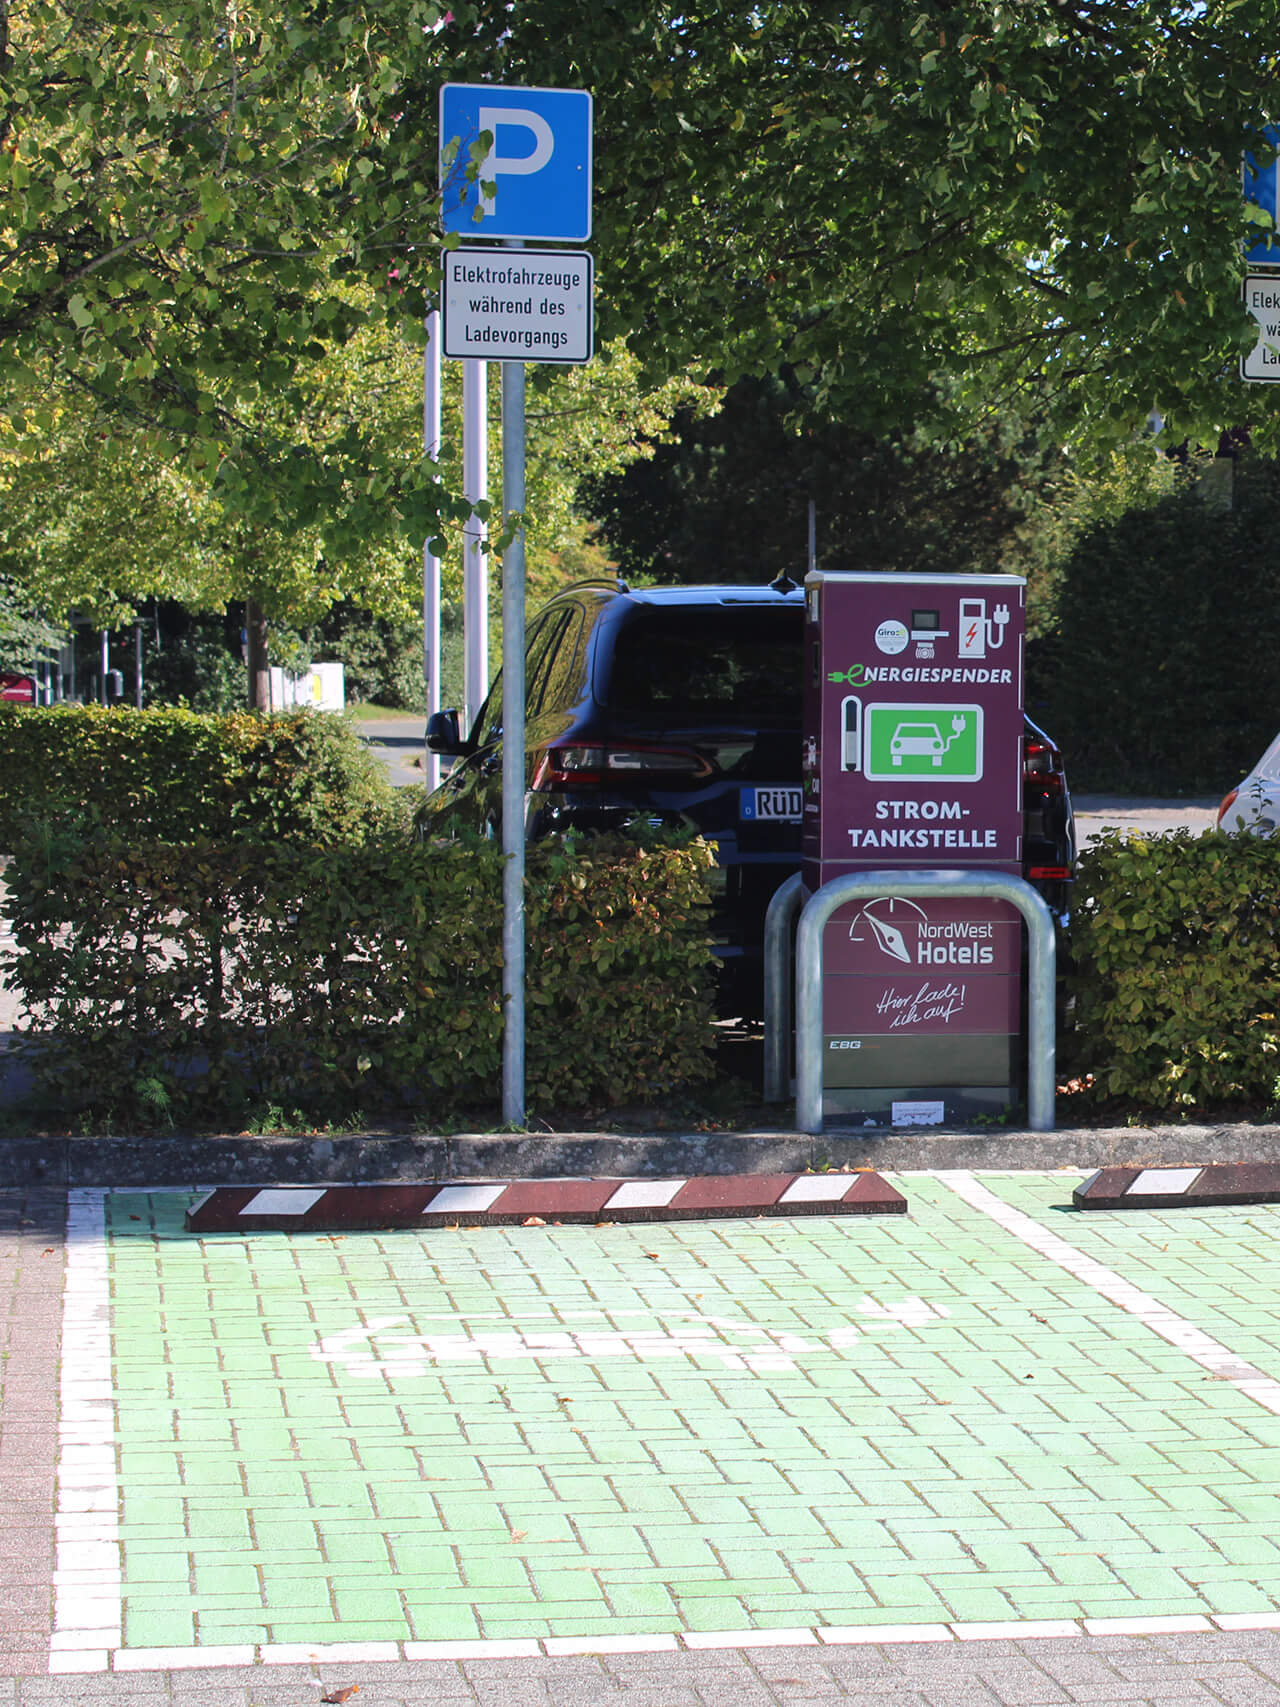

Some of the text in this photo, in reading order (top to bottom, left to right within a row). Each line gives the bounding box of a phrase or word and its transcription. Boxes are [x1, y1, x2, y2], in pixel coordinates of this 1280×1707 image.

[478, 106, 555, 217] P
[453, 265, 581, 291] Elektrofahrzeuge
[468, 296, 565, 316] während des
[464, 325, 568, 349] Ladevorgangs
[874, 800, 971, 820] STROM-
[847, 829, 997, 849] TANKSTELLE
[917, 922, 993, 939] NordWest
[917, 941, 994, 965] Hotels
[876, 987, 913, 1013] Hier
